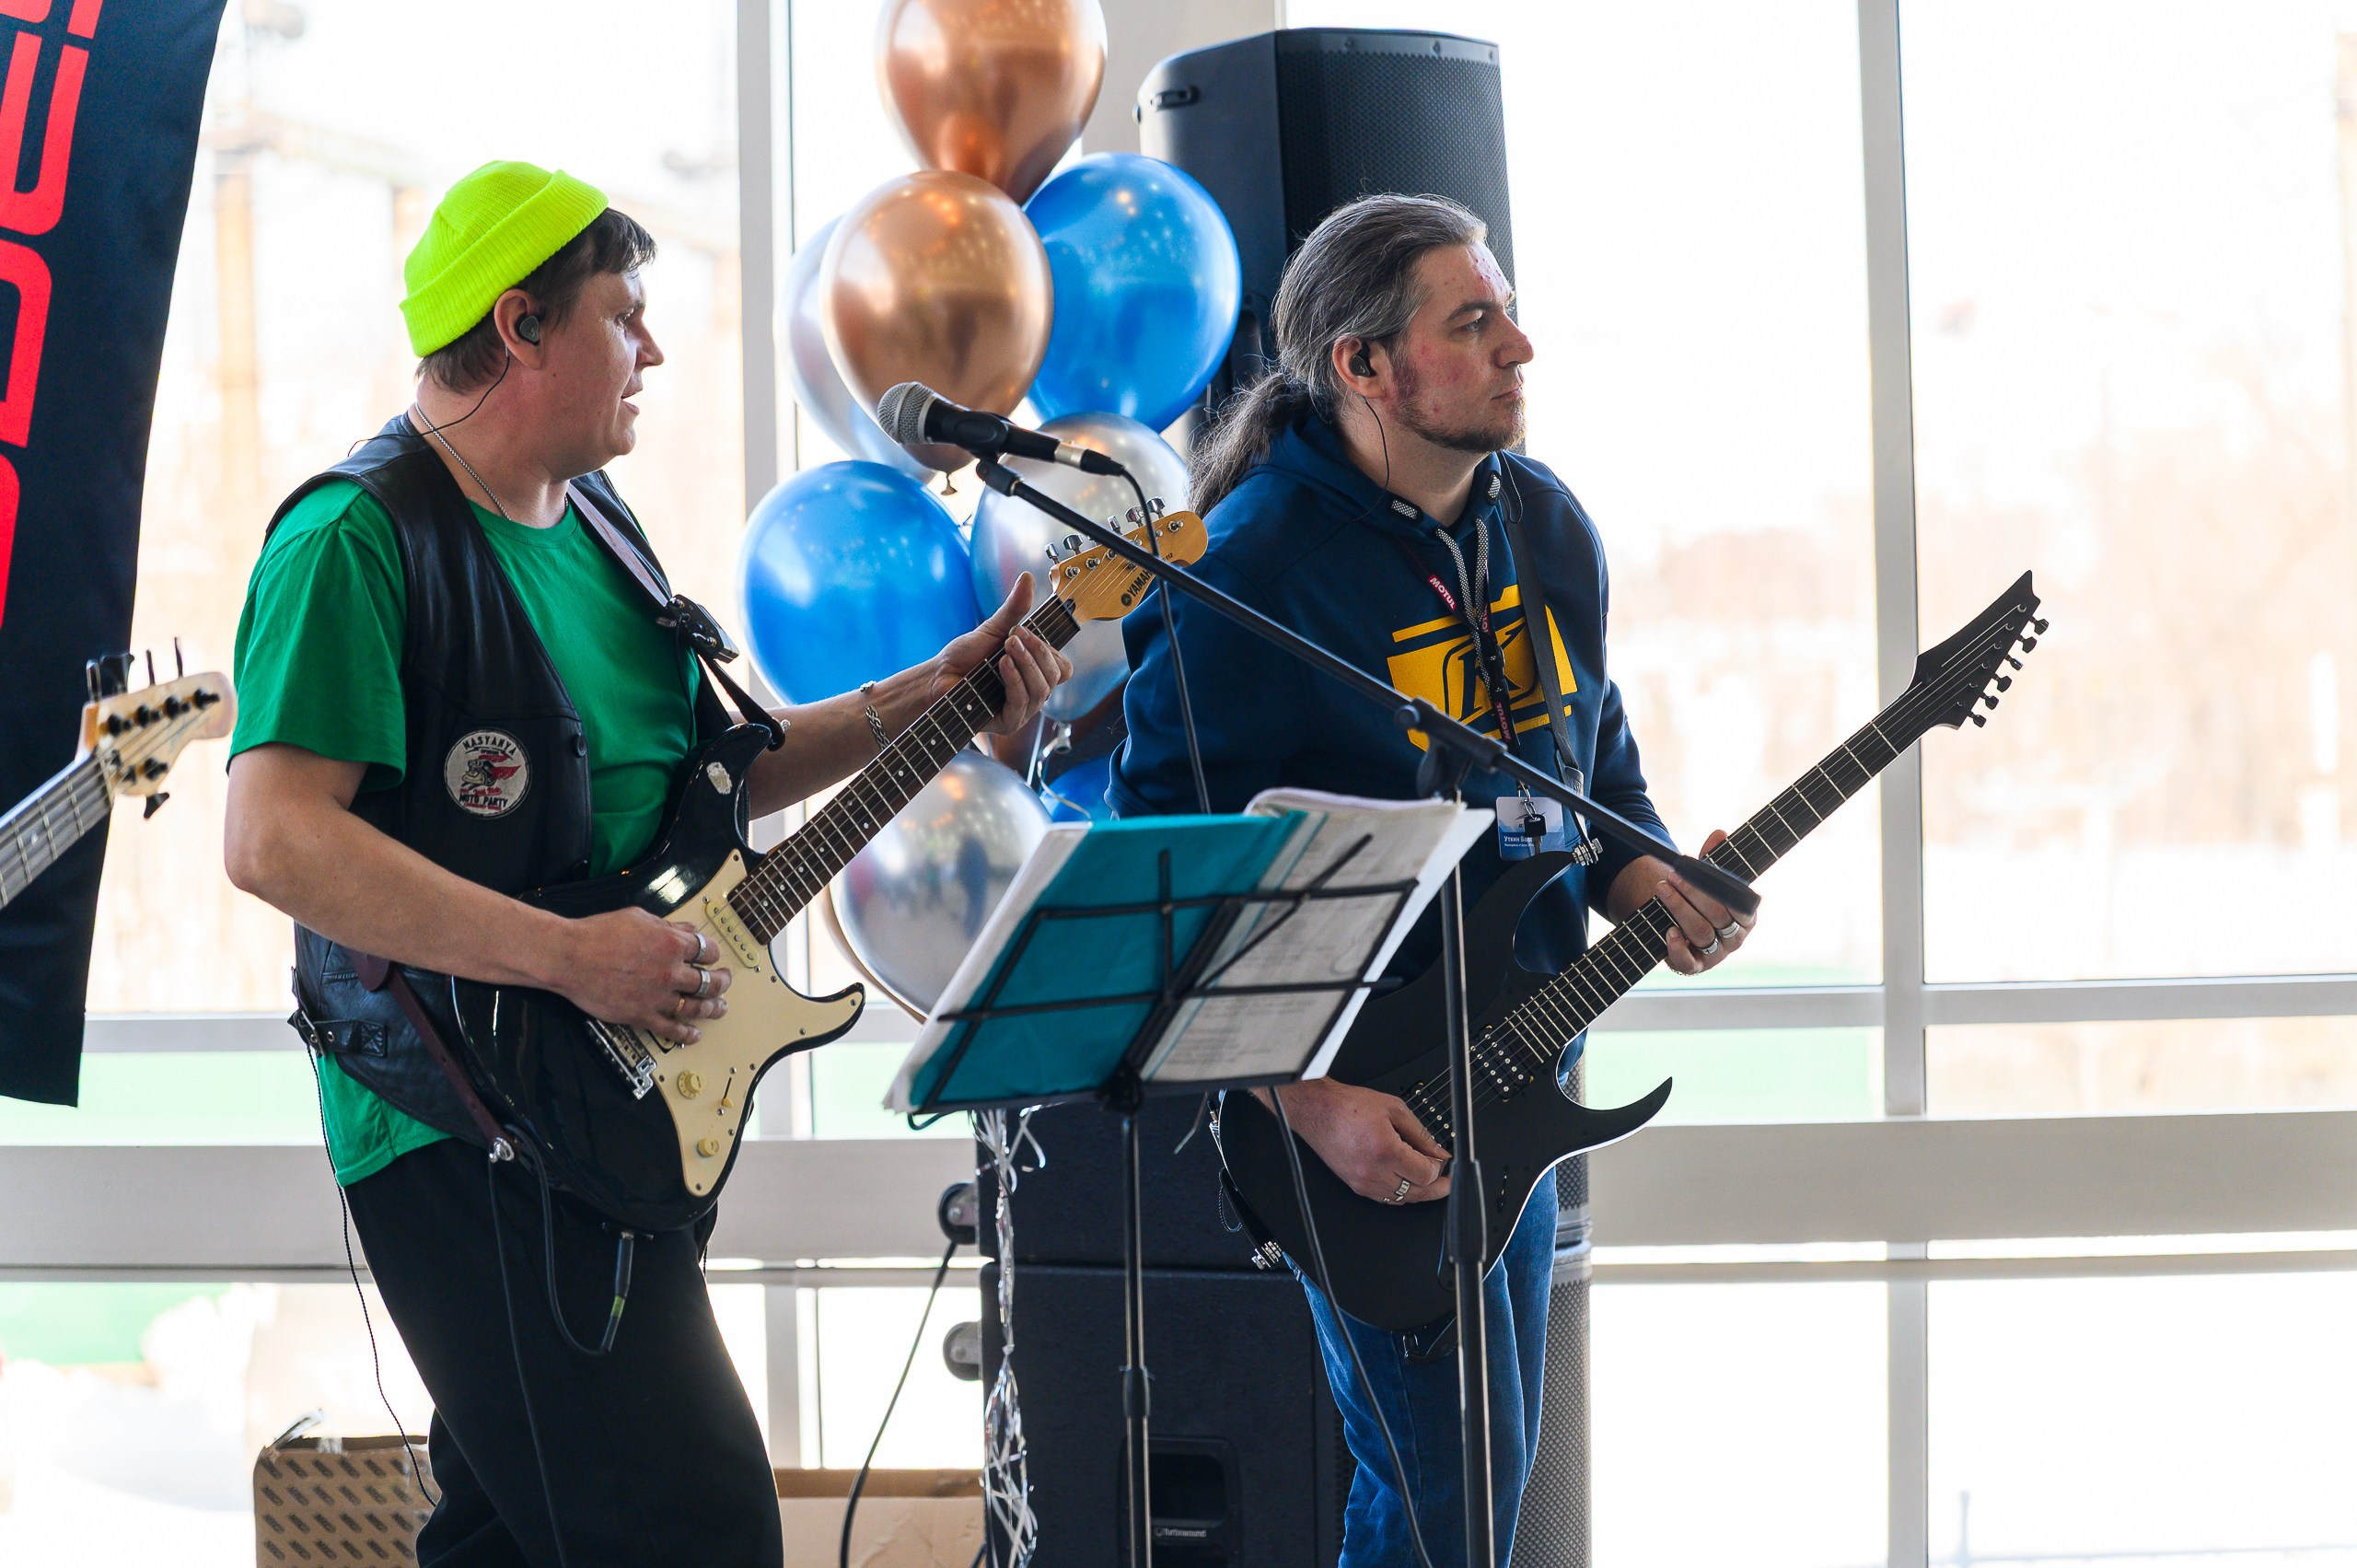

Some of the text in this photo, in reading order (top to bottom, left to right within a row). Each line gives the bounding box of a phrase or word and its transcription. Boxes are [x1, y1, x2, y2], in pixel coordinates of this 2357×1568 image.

[1126, 569, 1153, 598] YAMAH
[1429, 577, 1457, 610] MOTUL
[1495, 703, 1511, 741] MOTUL
[462, 736, 517, 756] MASYANYA
[459, 793, 480, 804] MOTO
[483, 796, 508, 807] PARTY
